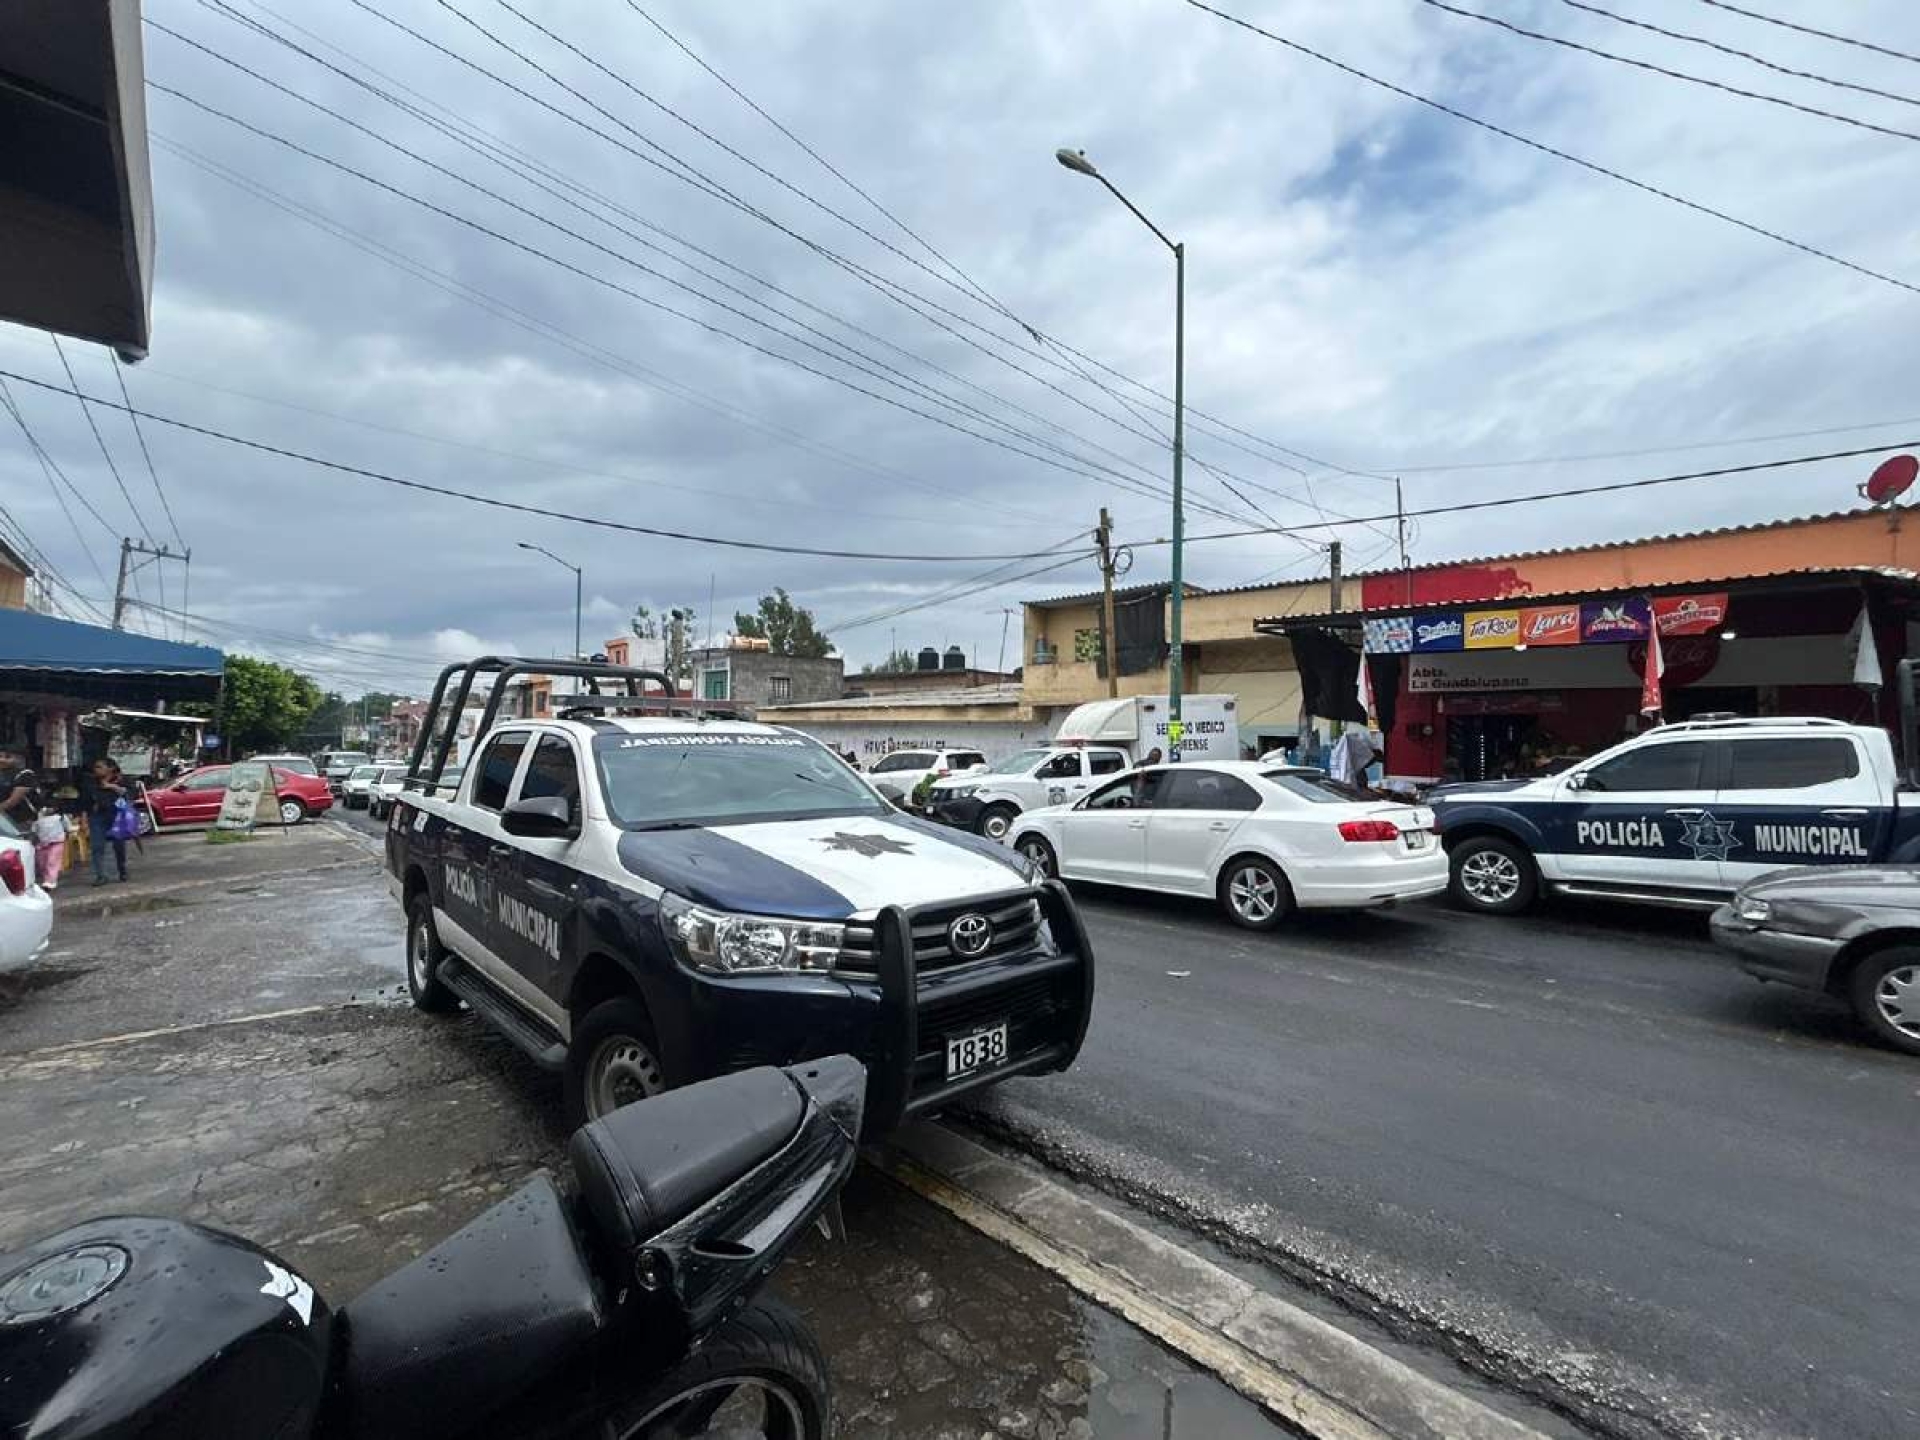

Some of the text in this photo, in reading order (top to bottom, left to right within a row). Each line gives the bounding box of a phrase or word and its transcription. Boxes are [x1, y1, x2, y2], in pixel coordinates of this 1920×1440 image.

[1577, 817, 1867, 857] POLICÍA MUNICIPAL
[498, 890, 560, 960] MUNICIPAL
[951, 1031, 1004, 1072] 1838
